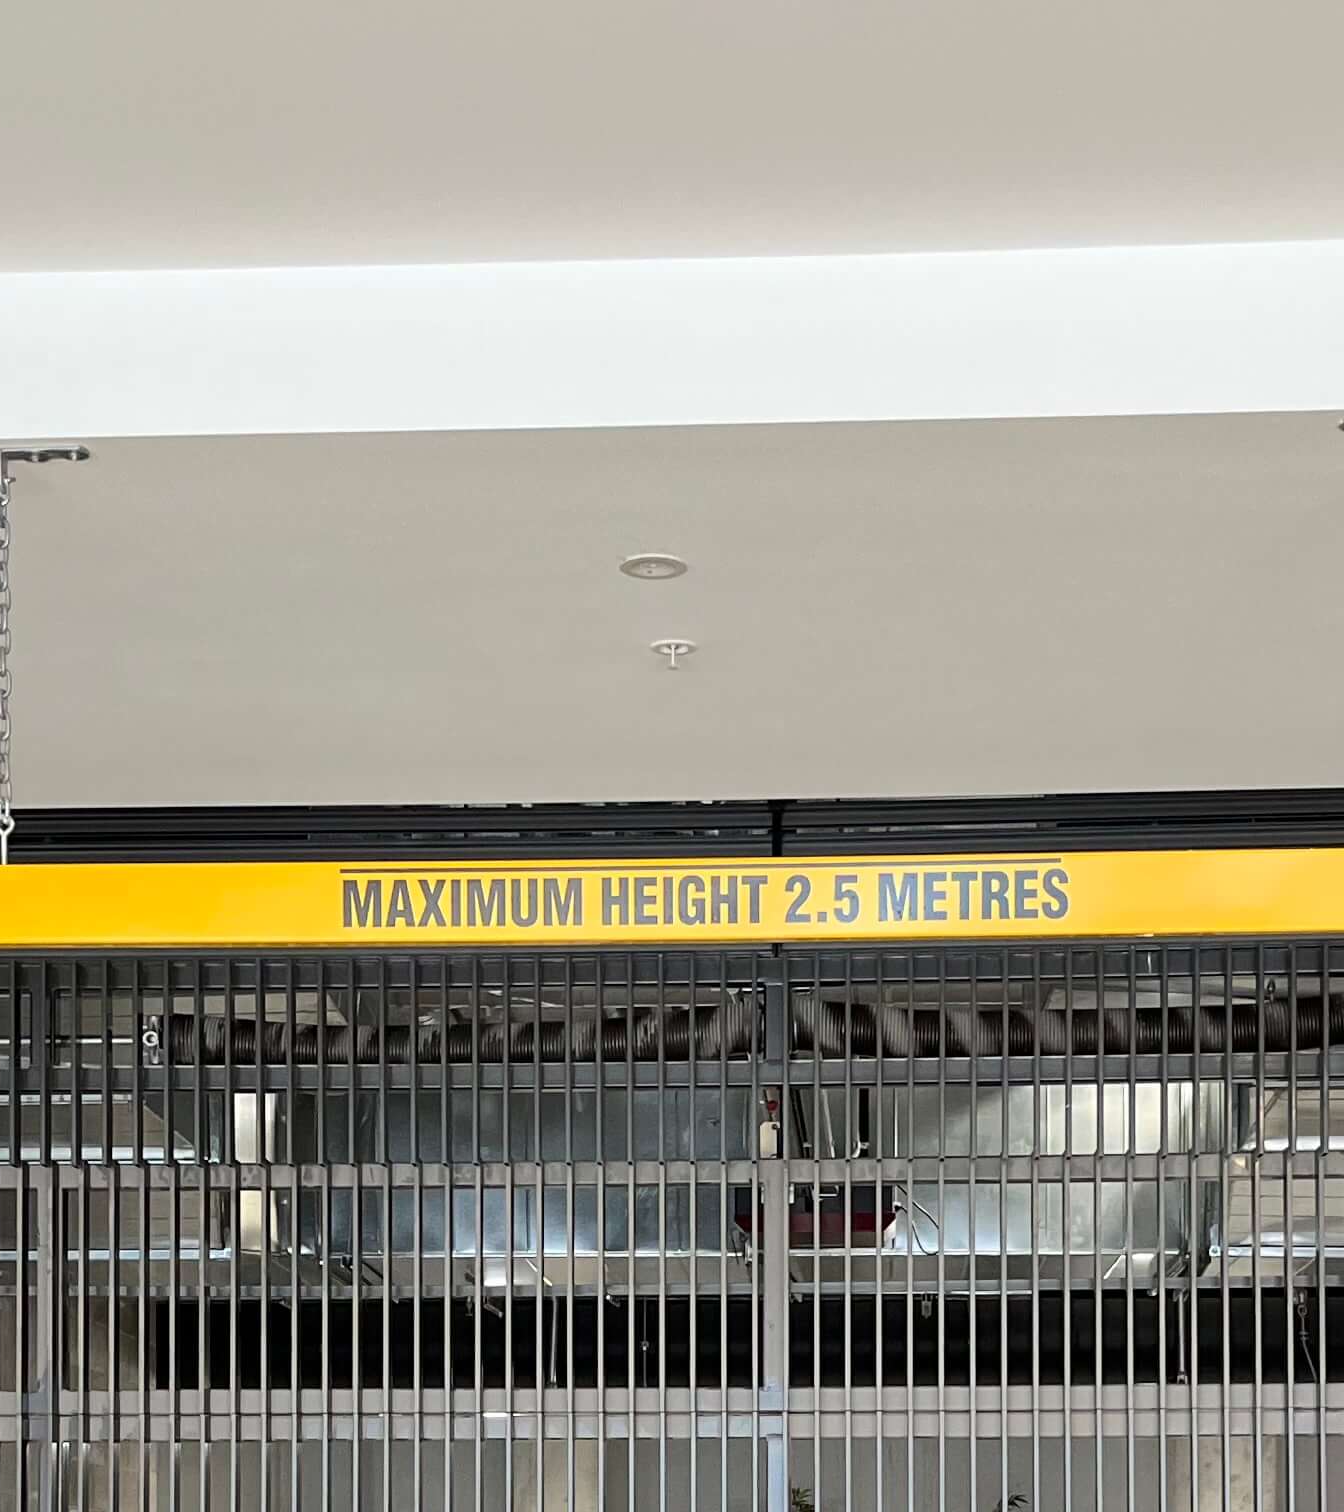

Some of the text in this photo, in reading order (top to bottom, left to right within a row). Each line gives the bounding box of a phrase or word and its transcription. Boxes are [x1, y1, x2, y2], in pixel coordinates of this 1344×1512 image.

[342, 868, 1069, 928] MAXIMUM HEIGHT 2.5 METRES
